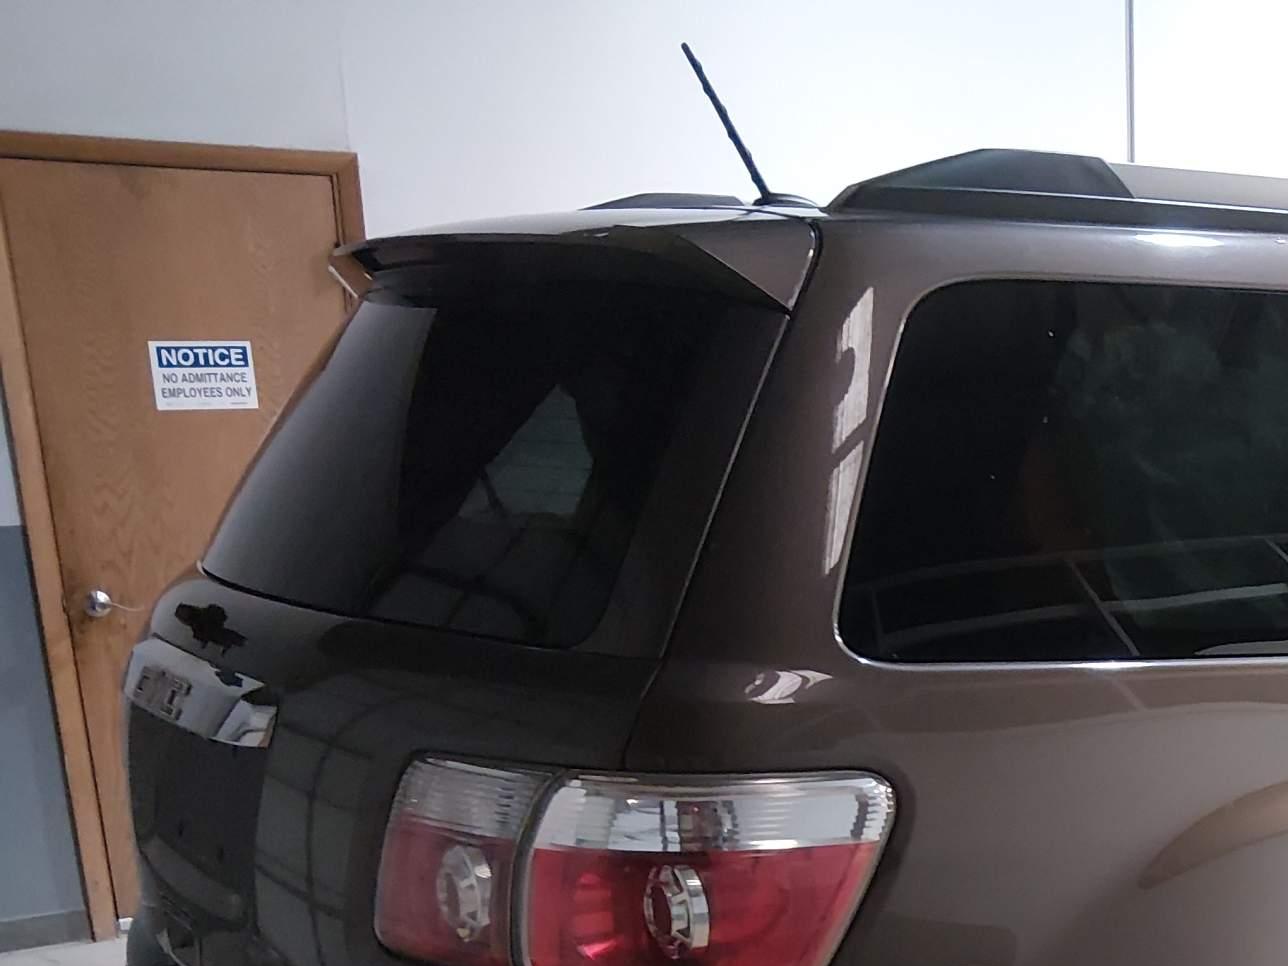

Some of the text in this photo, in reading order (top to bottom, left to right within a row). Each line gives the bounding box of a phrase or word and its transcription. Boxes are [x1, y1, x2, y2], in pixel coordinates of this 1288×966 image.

[160, 348, 245, 366] NOTICE
[162, 372, 248, 384] NO ADMITTANCE
[161, 386, 252, 399] EMPLOYEES ONLY
